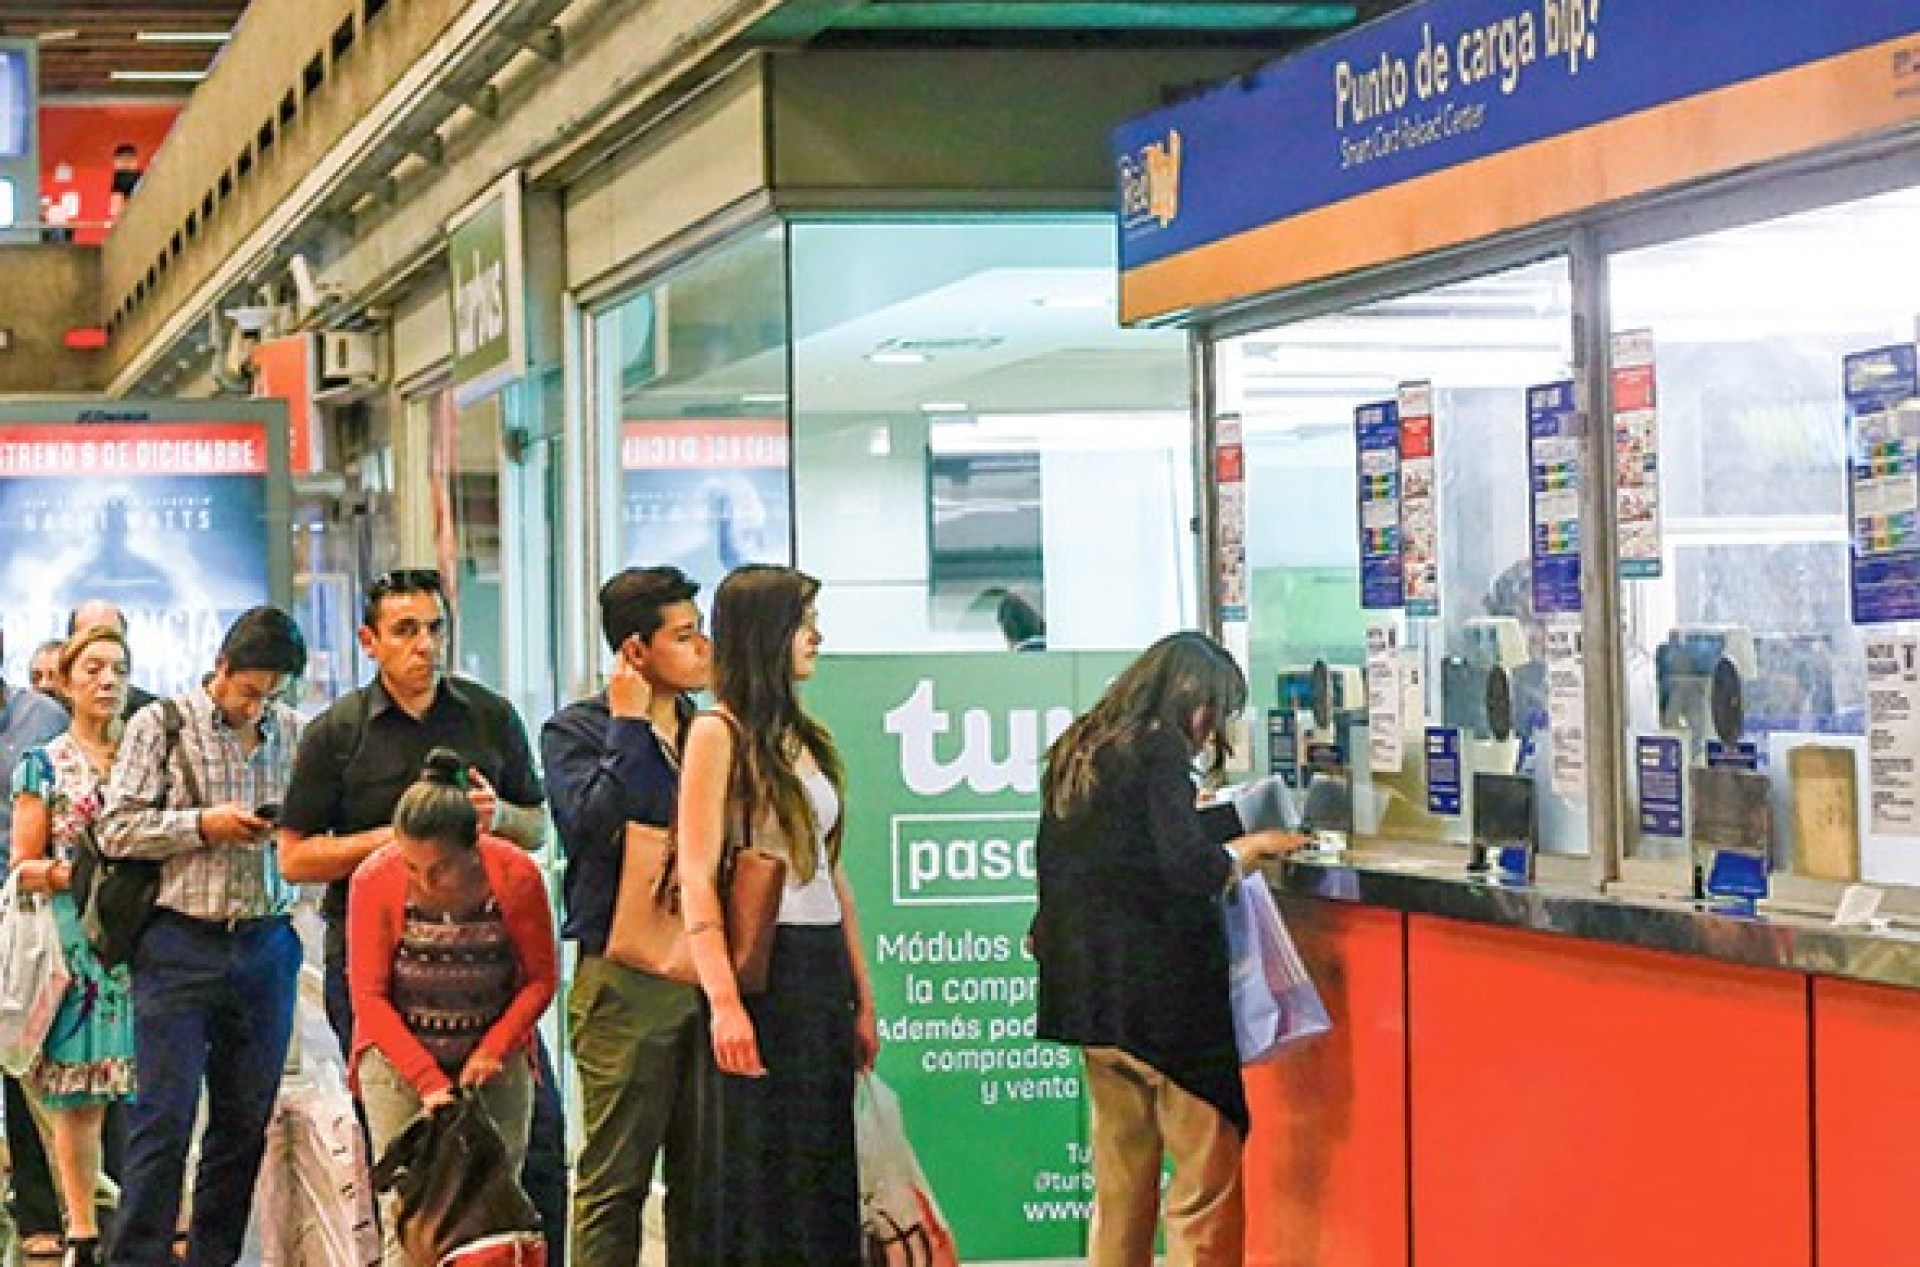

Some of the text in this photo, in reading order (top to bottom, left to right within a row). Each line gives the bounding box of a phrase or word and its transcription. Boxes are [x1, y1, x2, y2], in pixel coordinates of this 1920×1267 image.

[1336, 51, 1408, 129] Punto
[1415, 22, 1448, 100] de
[1457, 10, 1535, 94] carga
[103, 440, 130, 469] DE
[136, 438, 256, 469] DICIEMBRE
[877, 929, 1011, 964] Módulos
[906, 973, 933, 1004] la
[980, 1081, 998, 1105] y
